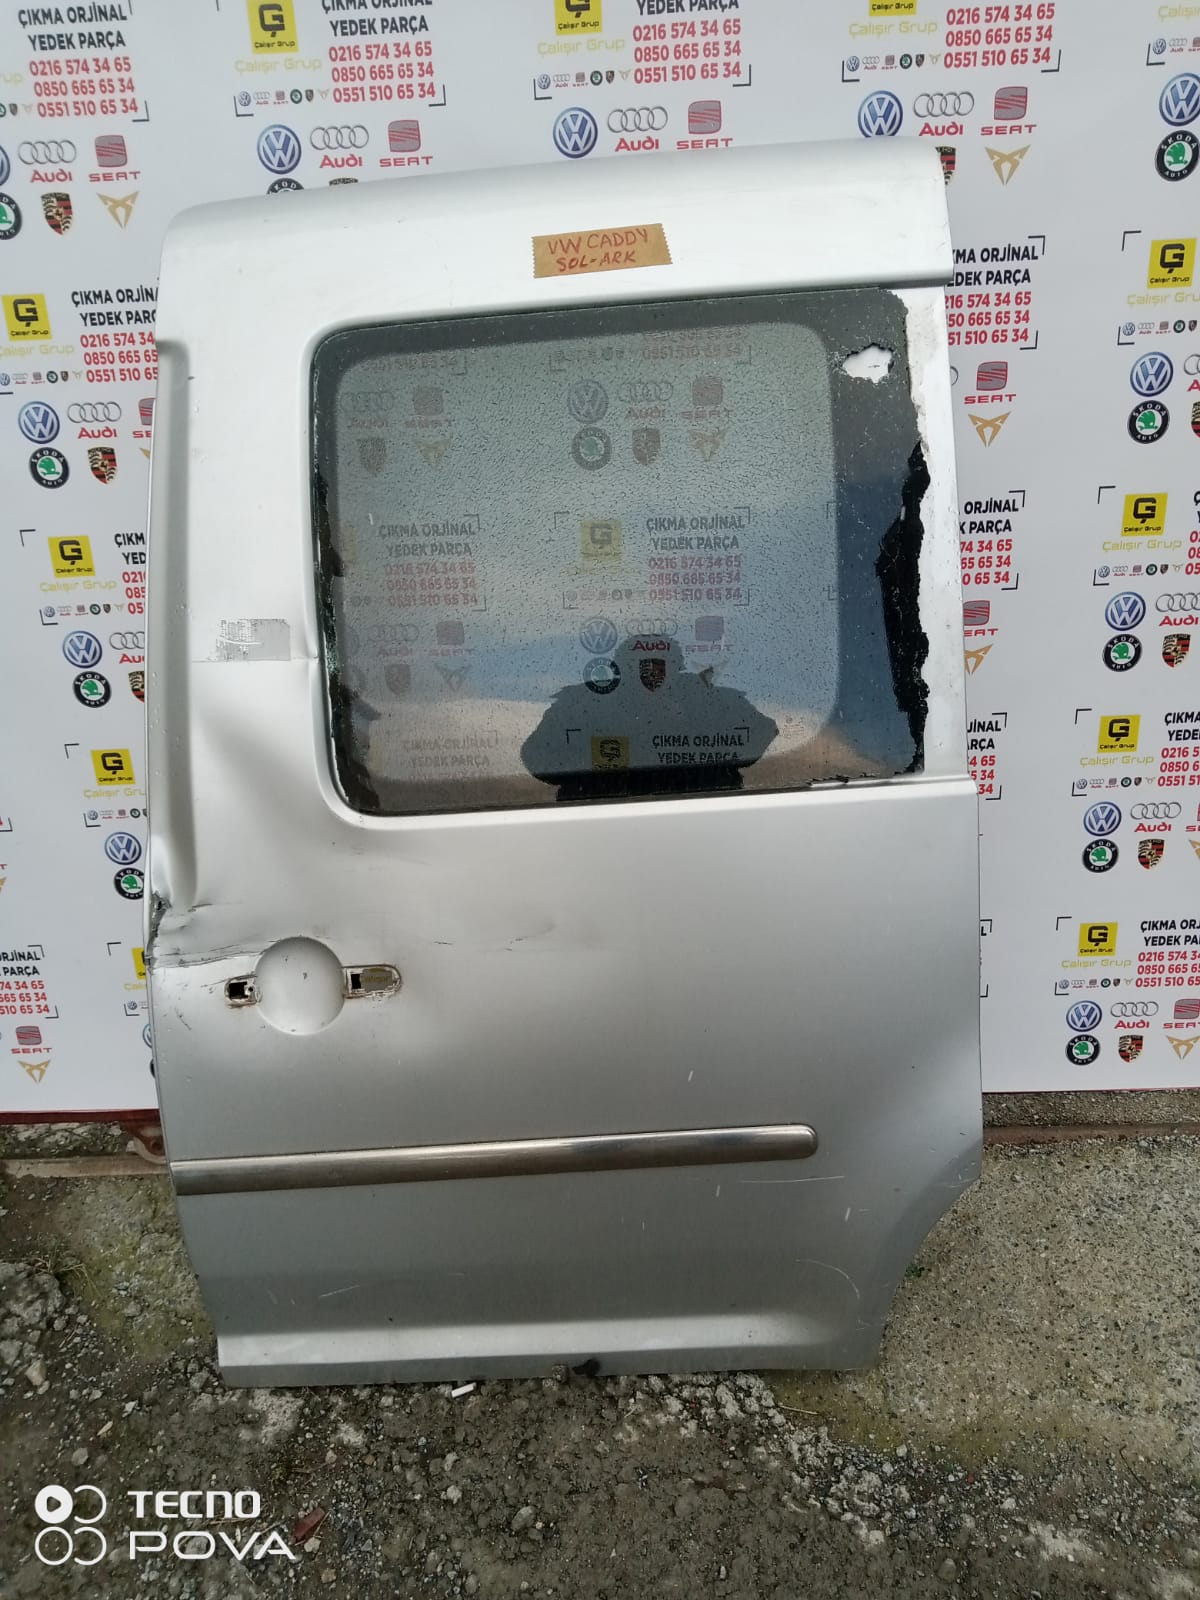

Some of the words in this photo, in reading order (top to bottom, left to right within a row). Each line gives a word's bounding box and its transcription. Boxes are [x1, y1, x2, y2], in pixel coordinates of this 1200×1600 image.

[18, 8, 65, 28] ÇIKMA
[68, 2, 127, 25] ORJİNAL
[636, 0, 685, 15] YEDEK
[690, 0, 739, 13] PARÇA
[946, 9, 980, 25] 0216
[985, 6, 1010, 23] 574
[1014, 4, 1032, 21] 34
[1036, 3, 1055, 19] 65
[330, 18, 377, 36] YEDEK
[381, 15, 429, 35] PARÇA
[633, 24, 667, 41] 0216
[671, 21, 696, 38] 574
[700, 20, 718, 37] 34
[723, 18, 741, 35] 65
[900, 21, 938, 35] Grup
[28, 33, 76, 52] YEDEK
[78, 29, 126, 50] PARÇA
[945, 30, 981, 47] 0850
[986, 28, 1011, 44] 665
[1015, 27, 1033, 43] 65
[1036, 25, 1053, 41] 34
[329, 45, 361, 62] 0216
[365, 43, 389, 60] 574
[393, 42, 411, 58] 34
[415, 41, 432, 57] 65
[587, 38, 625, 52] Grup
[634, 45, 669, 63] 0850
[673, 44, 699, 60] 665
[703, 42, 720, 58] 65
[724, 40, 741, 57] 34
[944, 51, 977, 68] 0551
[981, 49, 1006, 66] 510
[1010, 49, 1028, 65] 65
[1032, 47, 1050, 63] 34
[29, 60, 62, 77] 0216
[65, 58, 90, 75] 574
[93, 57, 112, 74] 34
[114, 56, 132, 72] 65
[332, 66, 365, 83] 0850
[370, 64, 394, 80] 665
[398, 63, 413, 79] 65
[417, 61, 434, 78] 34
[634, 67, 667, 84] 0551
[671, 65, 696, 82] 510
[700, 63, 719, 79] 65
[723, 61, 741, 78] 34
[34, 80, 67, 97] 0850
[71, 79, 96, 96] 665
[99, 78, 116, 95] 65
[118, 77, 135, 94] 34
[333, 87, 365, 103] 0551
[369, 85, 393, 101] 510
[397, 84, 414, 100] 65
[418, 82, 435, 98] 34
[37, 102, 71, 118] 0551
[73, 101, 96, 117] 510
[100, 100, 117, 116] 65
[119, 98, 138, 114] 34
[919, 122, 964, 137] Audi
[980, 124, 1037, 136] SEAT
[615, 137, 659, 152] Audi
[676, 138, 733, 150] SEAT
[319, 155, 363, 169] Audi
[379, 156, 433, 167] SEAT
[30, 169, 72, 183] Audi
[88, 171, 141, 182] SEAT
[547, 236, 581, 254] VW
[587, 228, 648, 249] CADDY
[980, 243, 1039, 263] ORJİNAL
[986, 269, 1031, 286] PARÇA
[71, 289, 113, 307] ÇIKMA
[967, 294, 990, 308] 574
[994, 292, 1010, 306] 34
[1014, 291, 1032, 305] 65
[80, 311, 123, 326] YEDEK
[967, 312, 992, 326] 665
[995, 311, 1011, 325] 65
[1014, 310, 1030, 323] 34
[80, 334, 110, 348] 0216
[114, 333, 135, 345] 574
[139, 332, 155, 345] 34
[964, 330, 987, 344] 510
[992, 329, 1008, 343] 65
[1011, 328, 1029, 341] 34
[84, 351, 114, 365] 0850
[119, 351, 141, 363] 665
[144, 350, 158, 363] 65
[86, 369, 115, 382] 0551
[119, 368, 141, 381] 510
[964, 394, 1016, 404] SEAT
[78, 427, 117, 439] Audi
[964, 498, 1018, 514] ORJİNAL
[969, 519, 1012, 534] PARÇA
[977, 540, 993, 552] 34
[997, 539, 1013, 551] 65
[1147, 540, 1182, 551] Grup
[1159, 615, 1199, 626] Audi
[632, 639, 671, 651] Audi
[653, 735, 690, 749] ÇIKMA
[693, 732, 744, 747] ORJİNAL
[1161, 747, 1189, 759] 0216
[1160, 761, 1189, 772] 0850
[1158, 776, 1185, 786] 0551
[1134, 822, 1172, 833] Audi
[1140, 920, 1176, 933] ÇIKMA
[1144, 935, 1181, 946] YEDEK
[1138, 951, 1164, 962] 0216
[1168, 951, 1187, 961] 574
[3, 966, 39, 978] PARÇA
[1137, 965, 1165, 975] 0850
[1168, 964, 1188, 974] 665
[14, 981, 28, 990] 34
[31, 980, 44, 989] 65
[1136, 977, 1161, 987] 0551
[1165, 977, 1184, 986] 510
[19, 993, 32, 1002] 65
[34, 992, 47, 1001] 34
[20, 1006, 32, 1014] 65
[36, 1004, 50, 1013] 34
[1114, 1020, 1150, 1029] Audi
